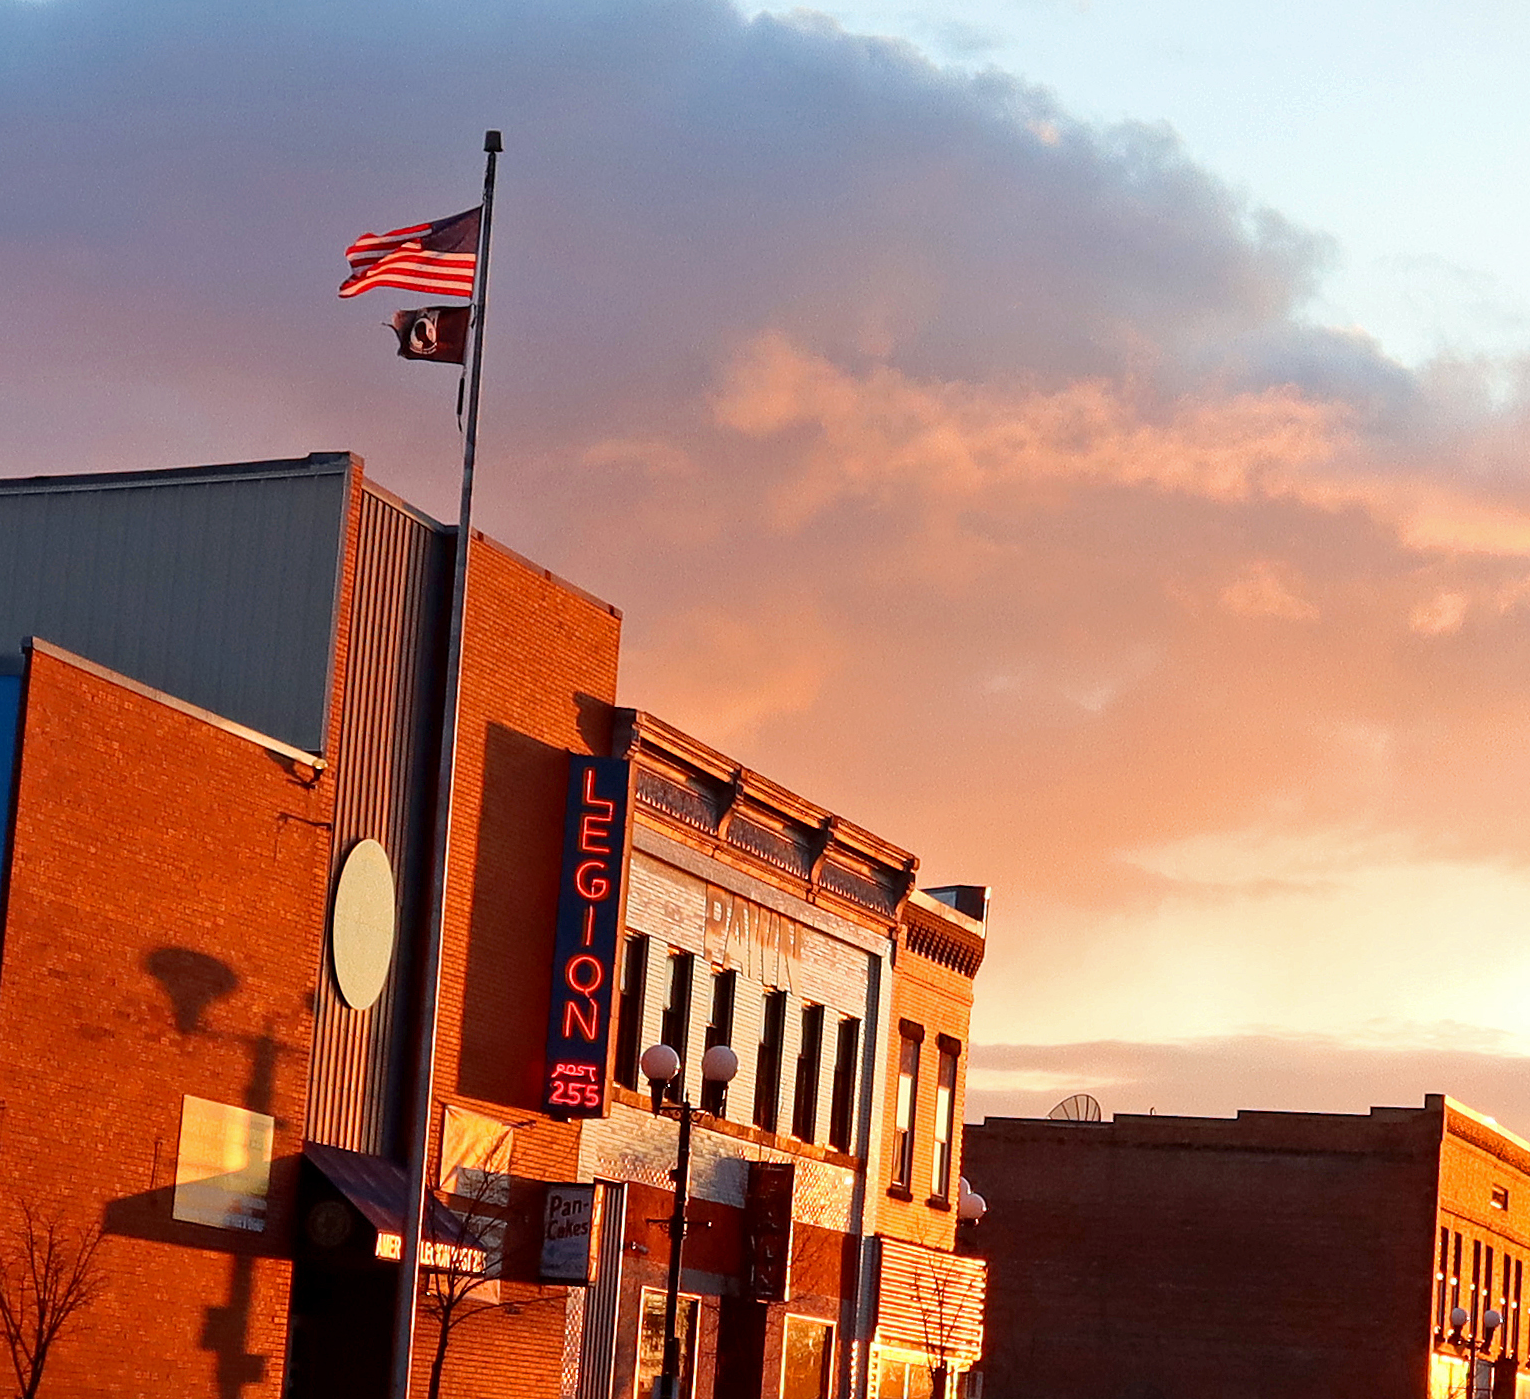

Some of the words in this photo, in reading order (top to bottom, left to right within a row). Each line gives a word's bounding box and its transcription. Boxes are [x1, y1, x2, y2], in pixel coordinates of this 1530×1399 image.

[563, 768, 615, 1041] LEGION
[704, 883, 802, 996] PAWN
[551, 1063, 597, 1083] POST
[551, 1081, 600, 1107] 255
[550, 1195, 589, 1218] Pan-
[547, 1220, 588, 1240] Cakes
